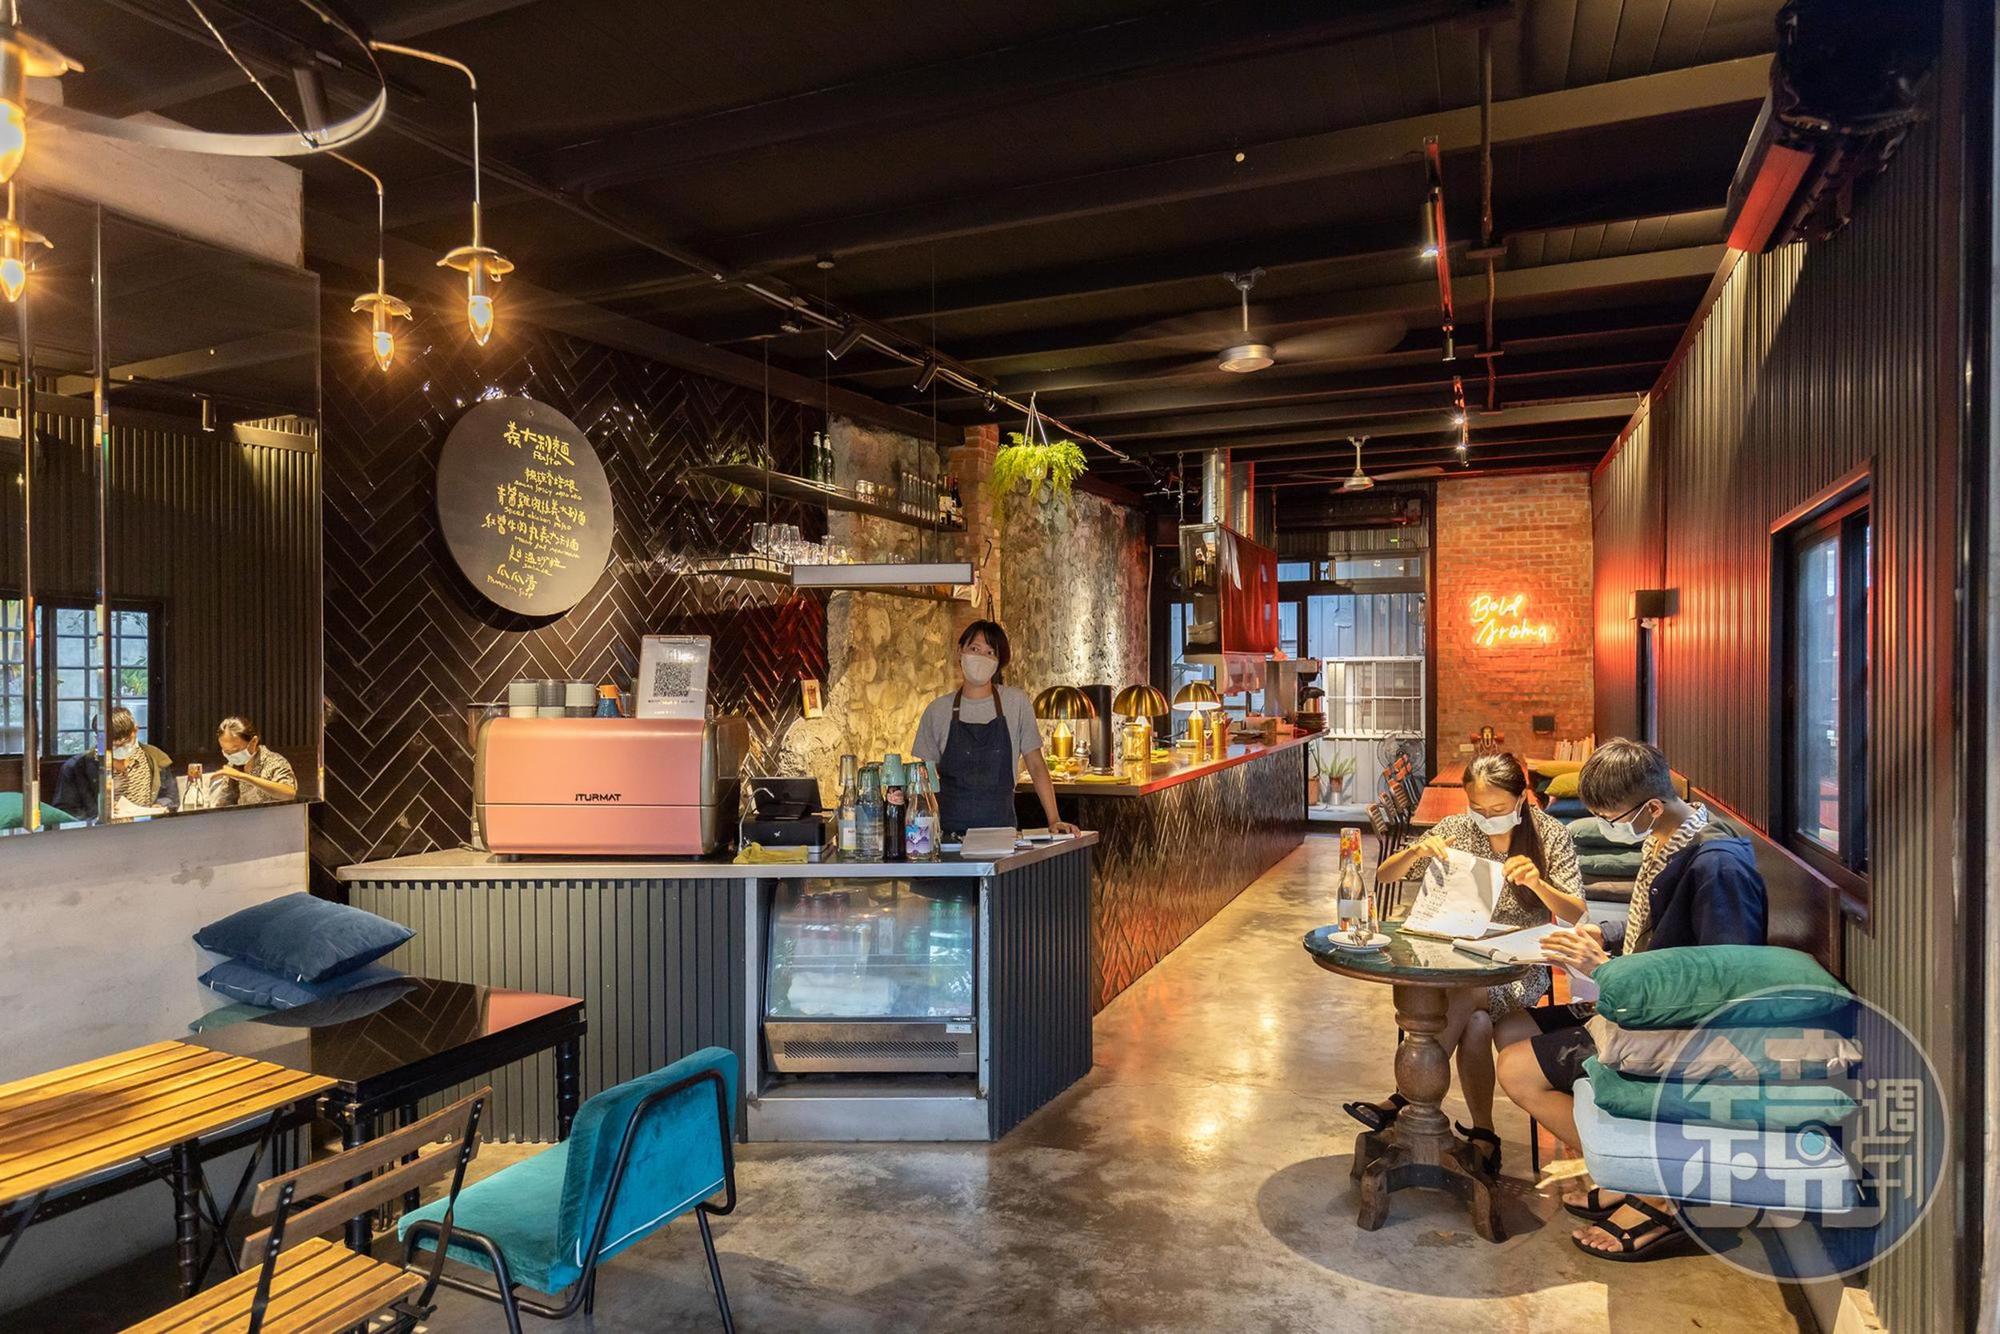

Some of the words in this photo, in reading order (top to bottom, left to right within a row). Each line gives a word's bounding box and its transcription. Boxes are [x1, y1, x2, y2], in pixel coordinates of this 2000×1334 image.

[503, 420, 575, 466] 義大利麵
[532, 450, 562, 466] Pasta
[1470, 594, 1523, 623] Bold
